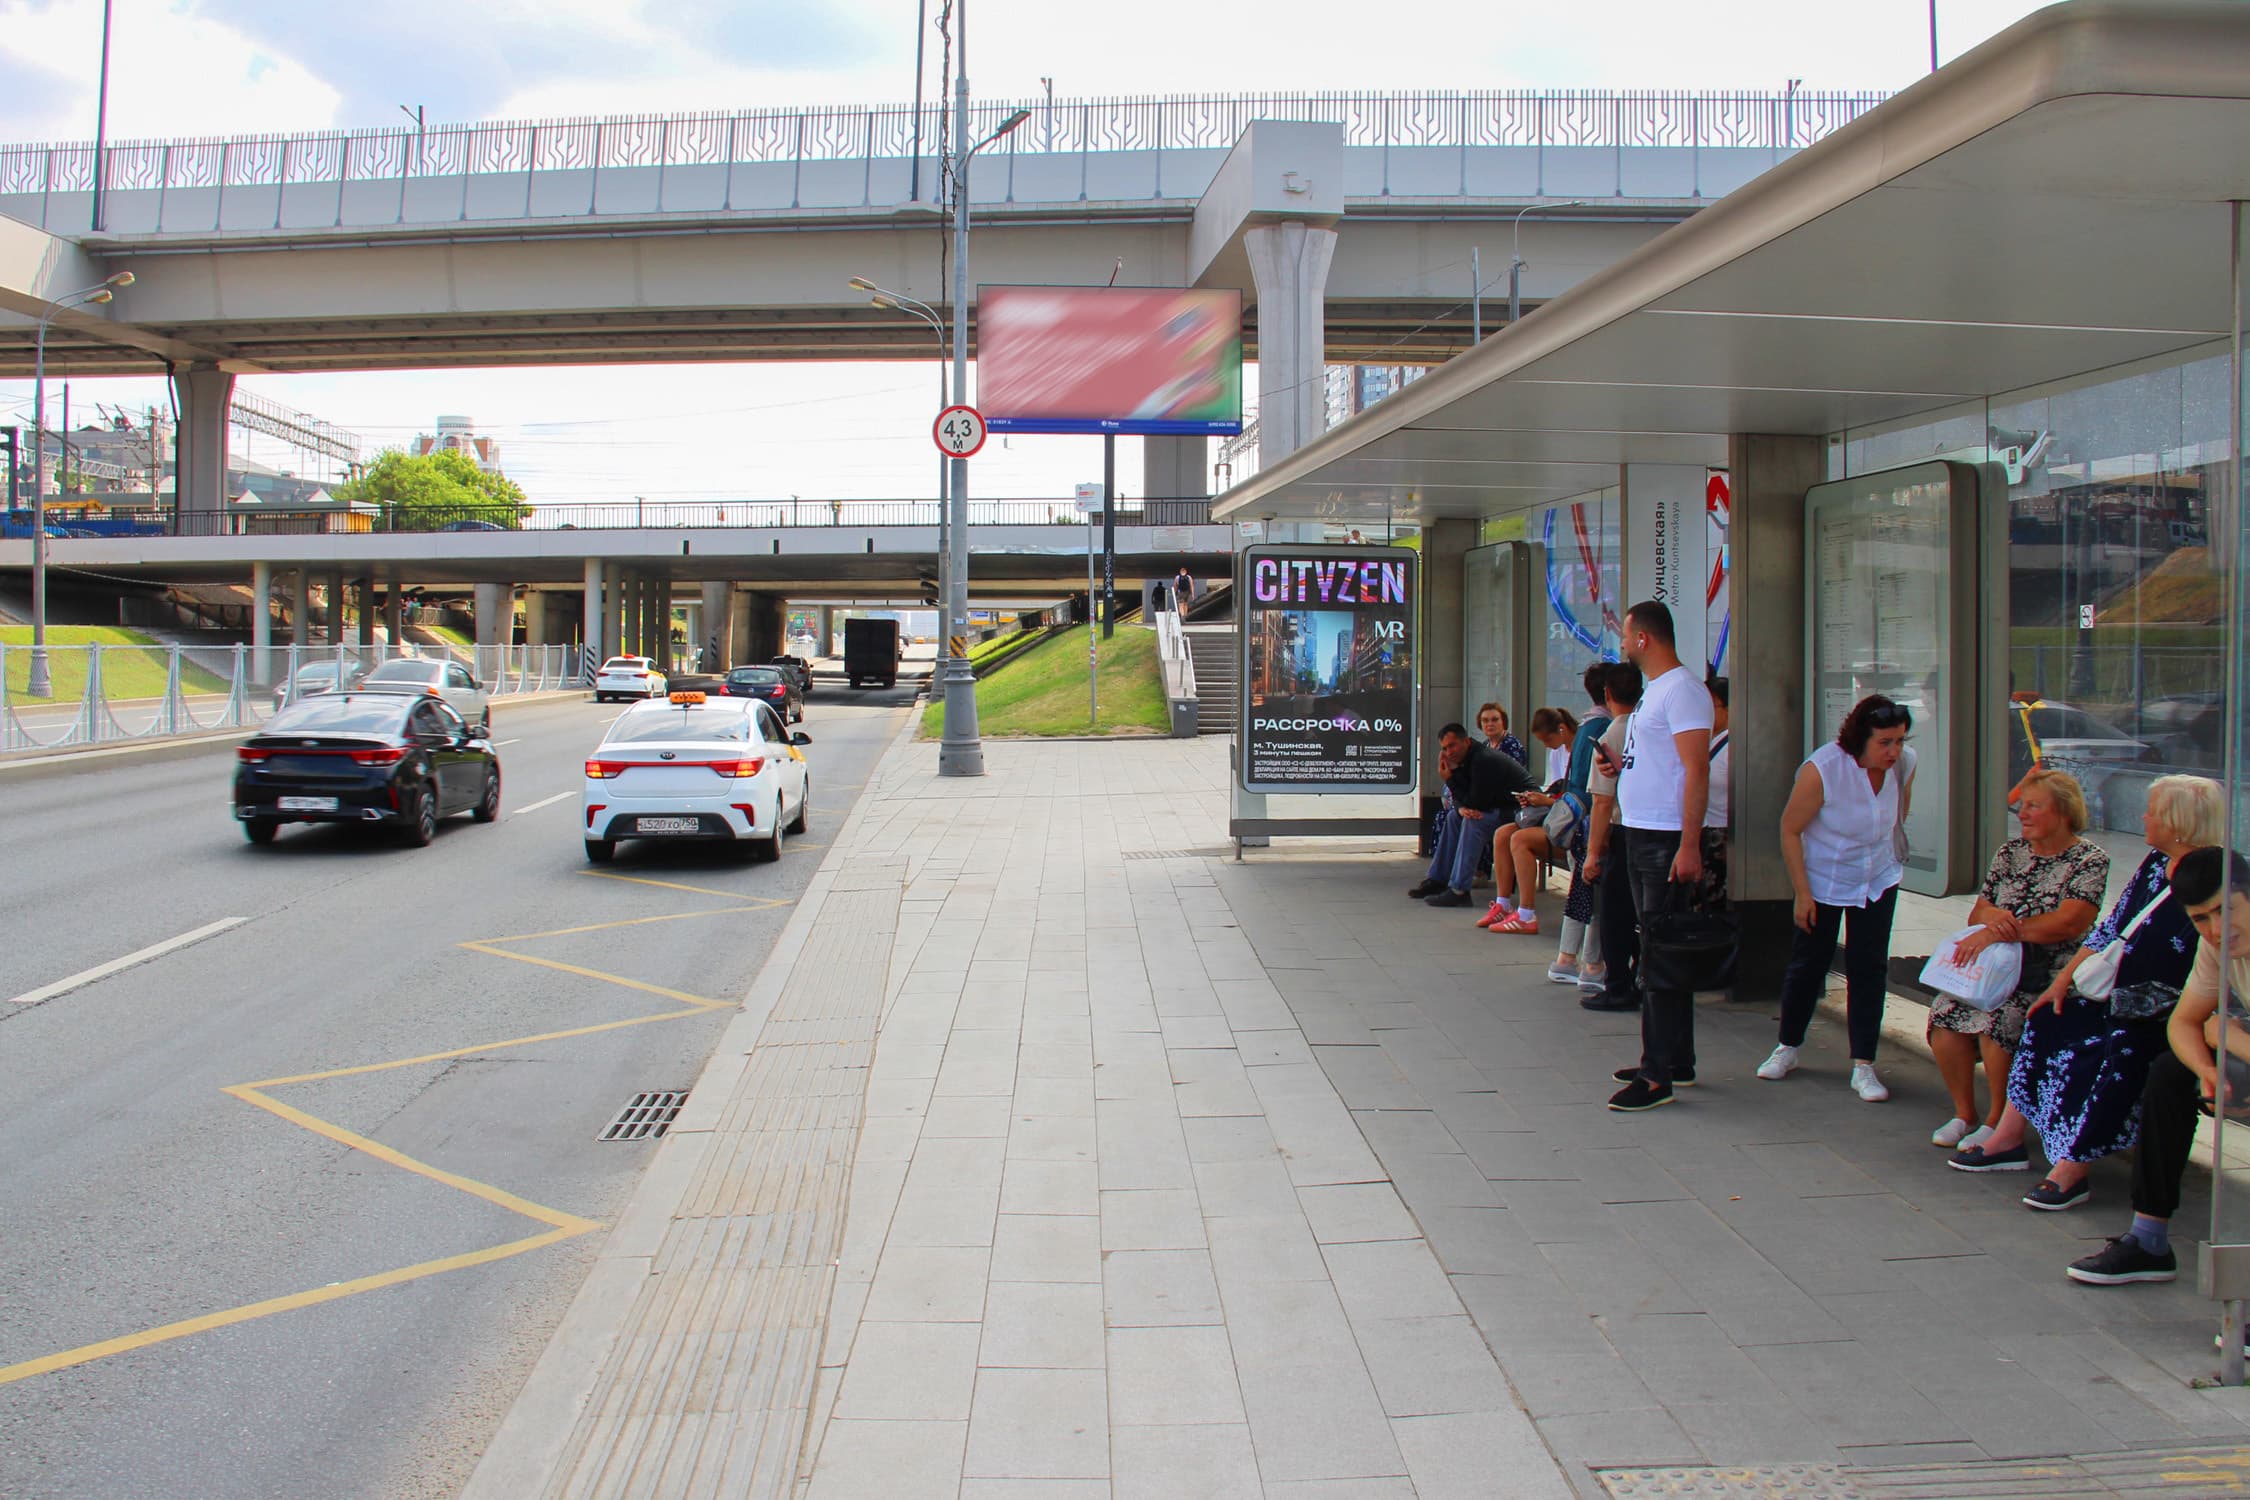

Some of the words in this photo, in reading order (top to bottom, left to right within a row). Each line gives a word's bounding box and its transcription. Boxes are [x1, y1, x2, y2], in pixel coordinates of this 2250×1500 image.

[944, 419, 972, 441] 4,3
[1670, 502, 1680, 571] Kuntsevskaya
[1255, 559, 1405, 603] CITYZEN
[1671, 576, 1679, 606] Metro
[1375, 620, 1405, 640] MR
[1254, 718, 1370, 732] РАССРОЧКА
[1374, 718, 1402, 733] 0%
[1265, 741, 1324, 750] Тушинская,
